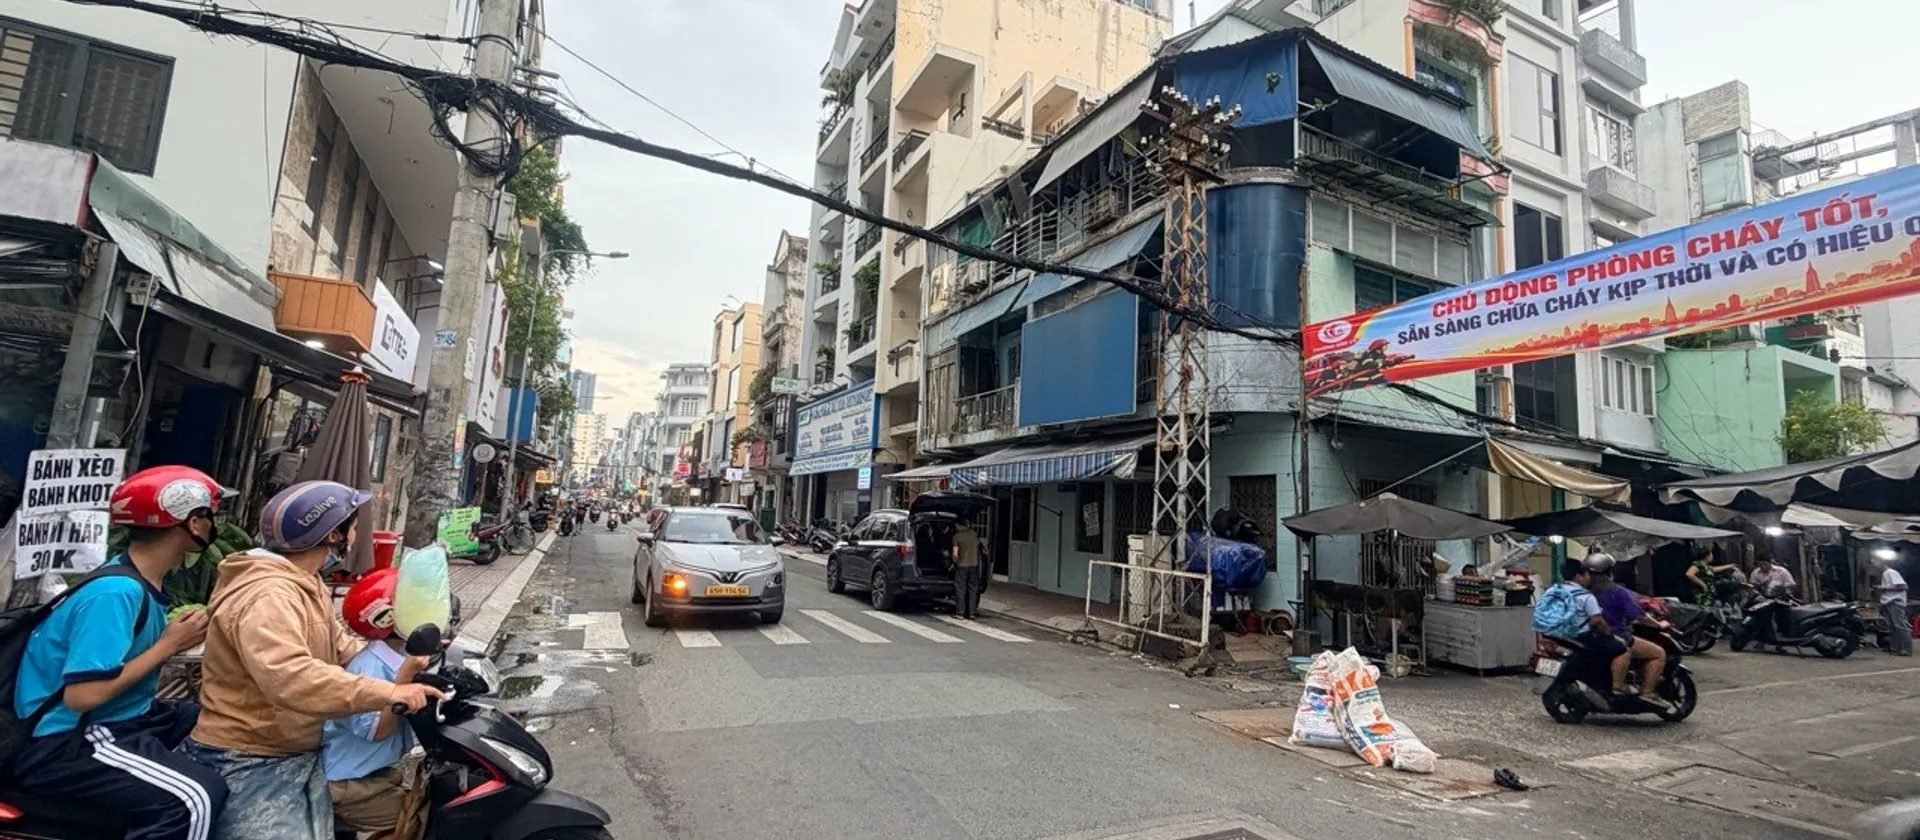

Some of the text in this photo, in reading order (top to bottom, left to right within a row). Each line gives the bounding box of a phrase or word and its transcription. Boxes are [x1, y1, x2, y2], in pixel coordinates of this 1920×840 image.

[1432, 290, 1477, 318] CHỦ
[1485, 274, 1558, 306] ĐỘNG
[1567, 245, 1675, 287] PHÒNG
[1687, 217, 1784, 258] CHÁY
[1798, 193, 1889, 232] TỐT,
[1434, 315, 1481, 337] SÀNG
[1487, 302, 1539, 326] CHỮA
[1545, 287, 1601, 313] CHÁY
[1608, 278, 1647, 301] KỊP
[1653, 262, 1712, 290] THỜI
[1719, 251, 1758, 276] VÀ
[1766, 239, 1807, 266] CÓ
[1815, 222, 1893, 256] HIỆU
[33, 453, 115, 480] BÁNH XÈO
[28, 482, 113, 508] BÁNH KHỌT
[19, 519, 49, 546] BÁNH
